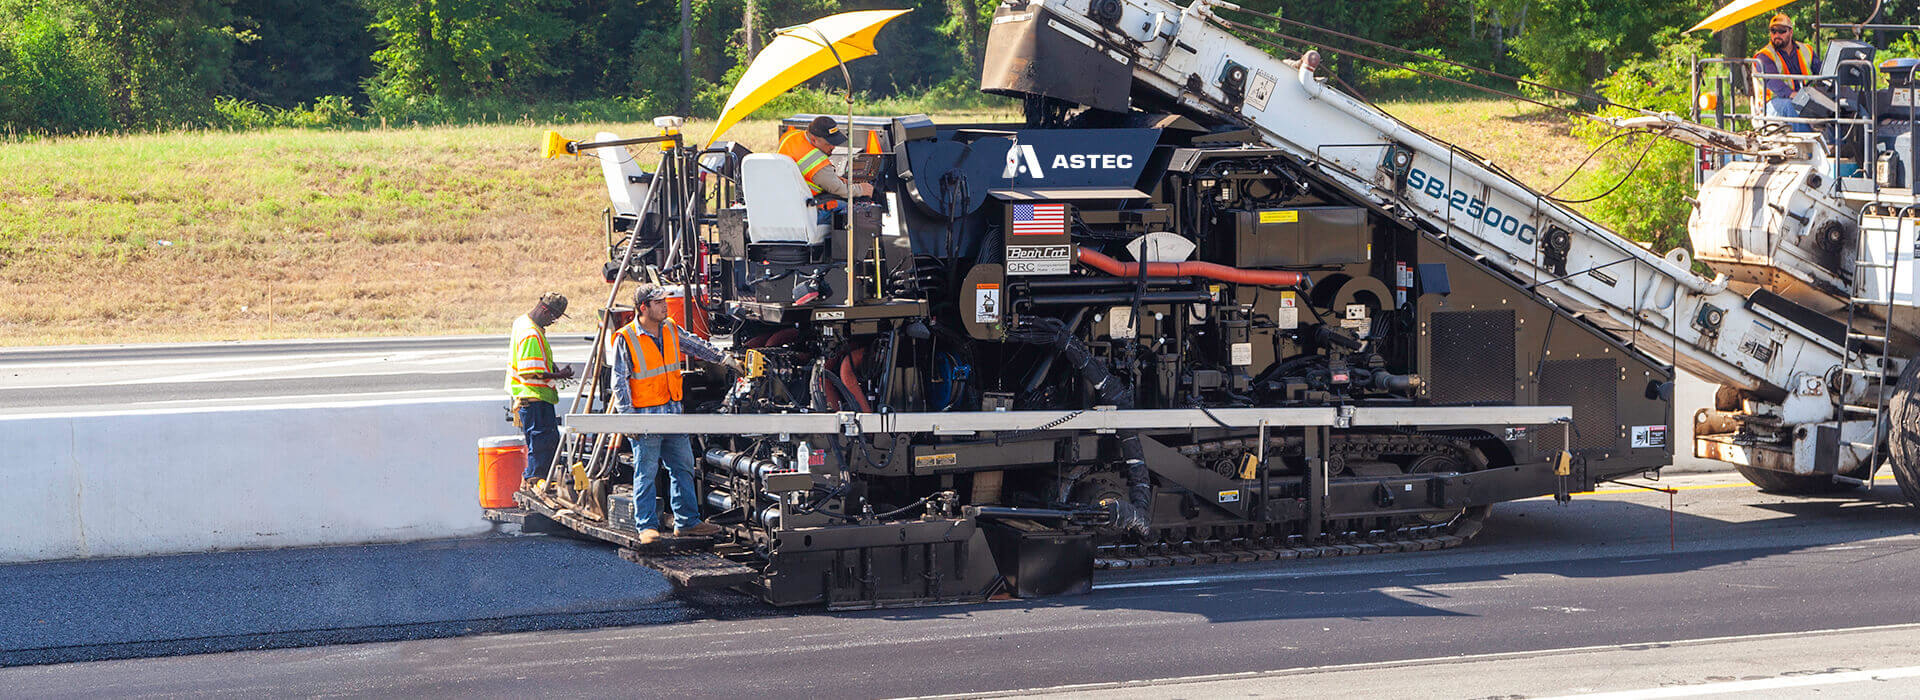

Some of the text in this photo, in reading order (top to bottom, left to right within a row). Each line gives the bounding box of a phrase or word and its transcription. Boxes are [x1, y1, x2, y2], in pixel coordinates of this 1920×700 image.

[1052, 154, 1133, 169] ASTEC
[1407, 168, 1536, 245] SB-2500C
[1043, 247, 1069, 258] Cat
[1008, 263, 1035, 271] CRC
